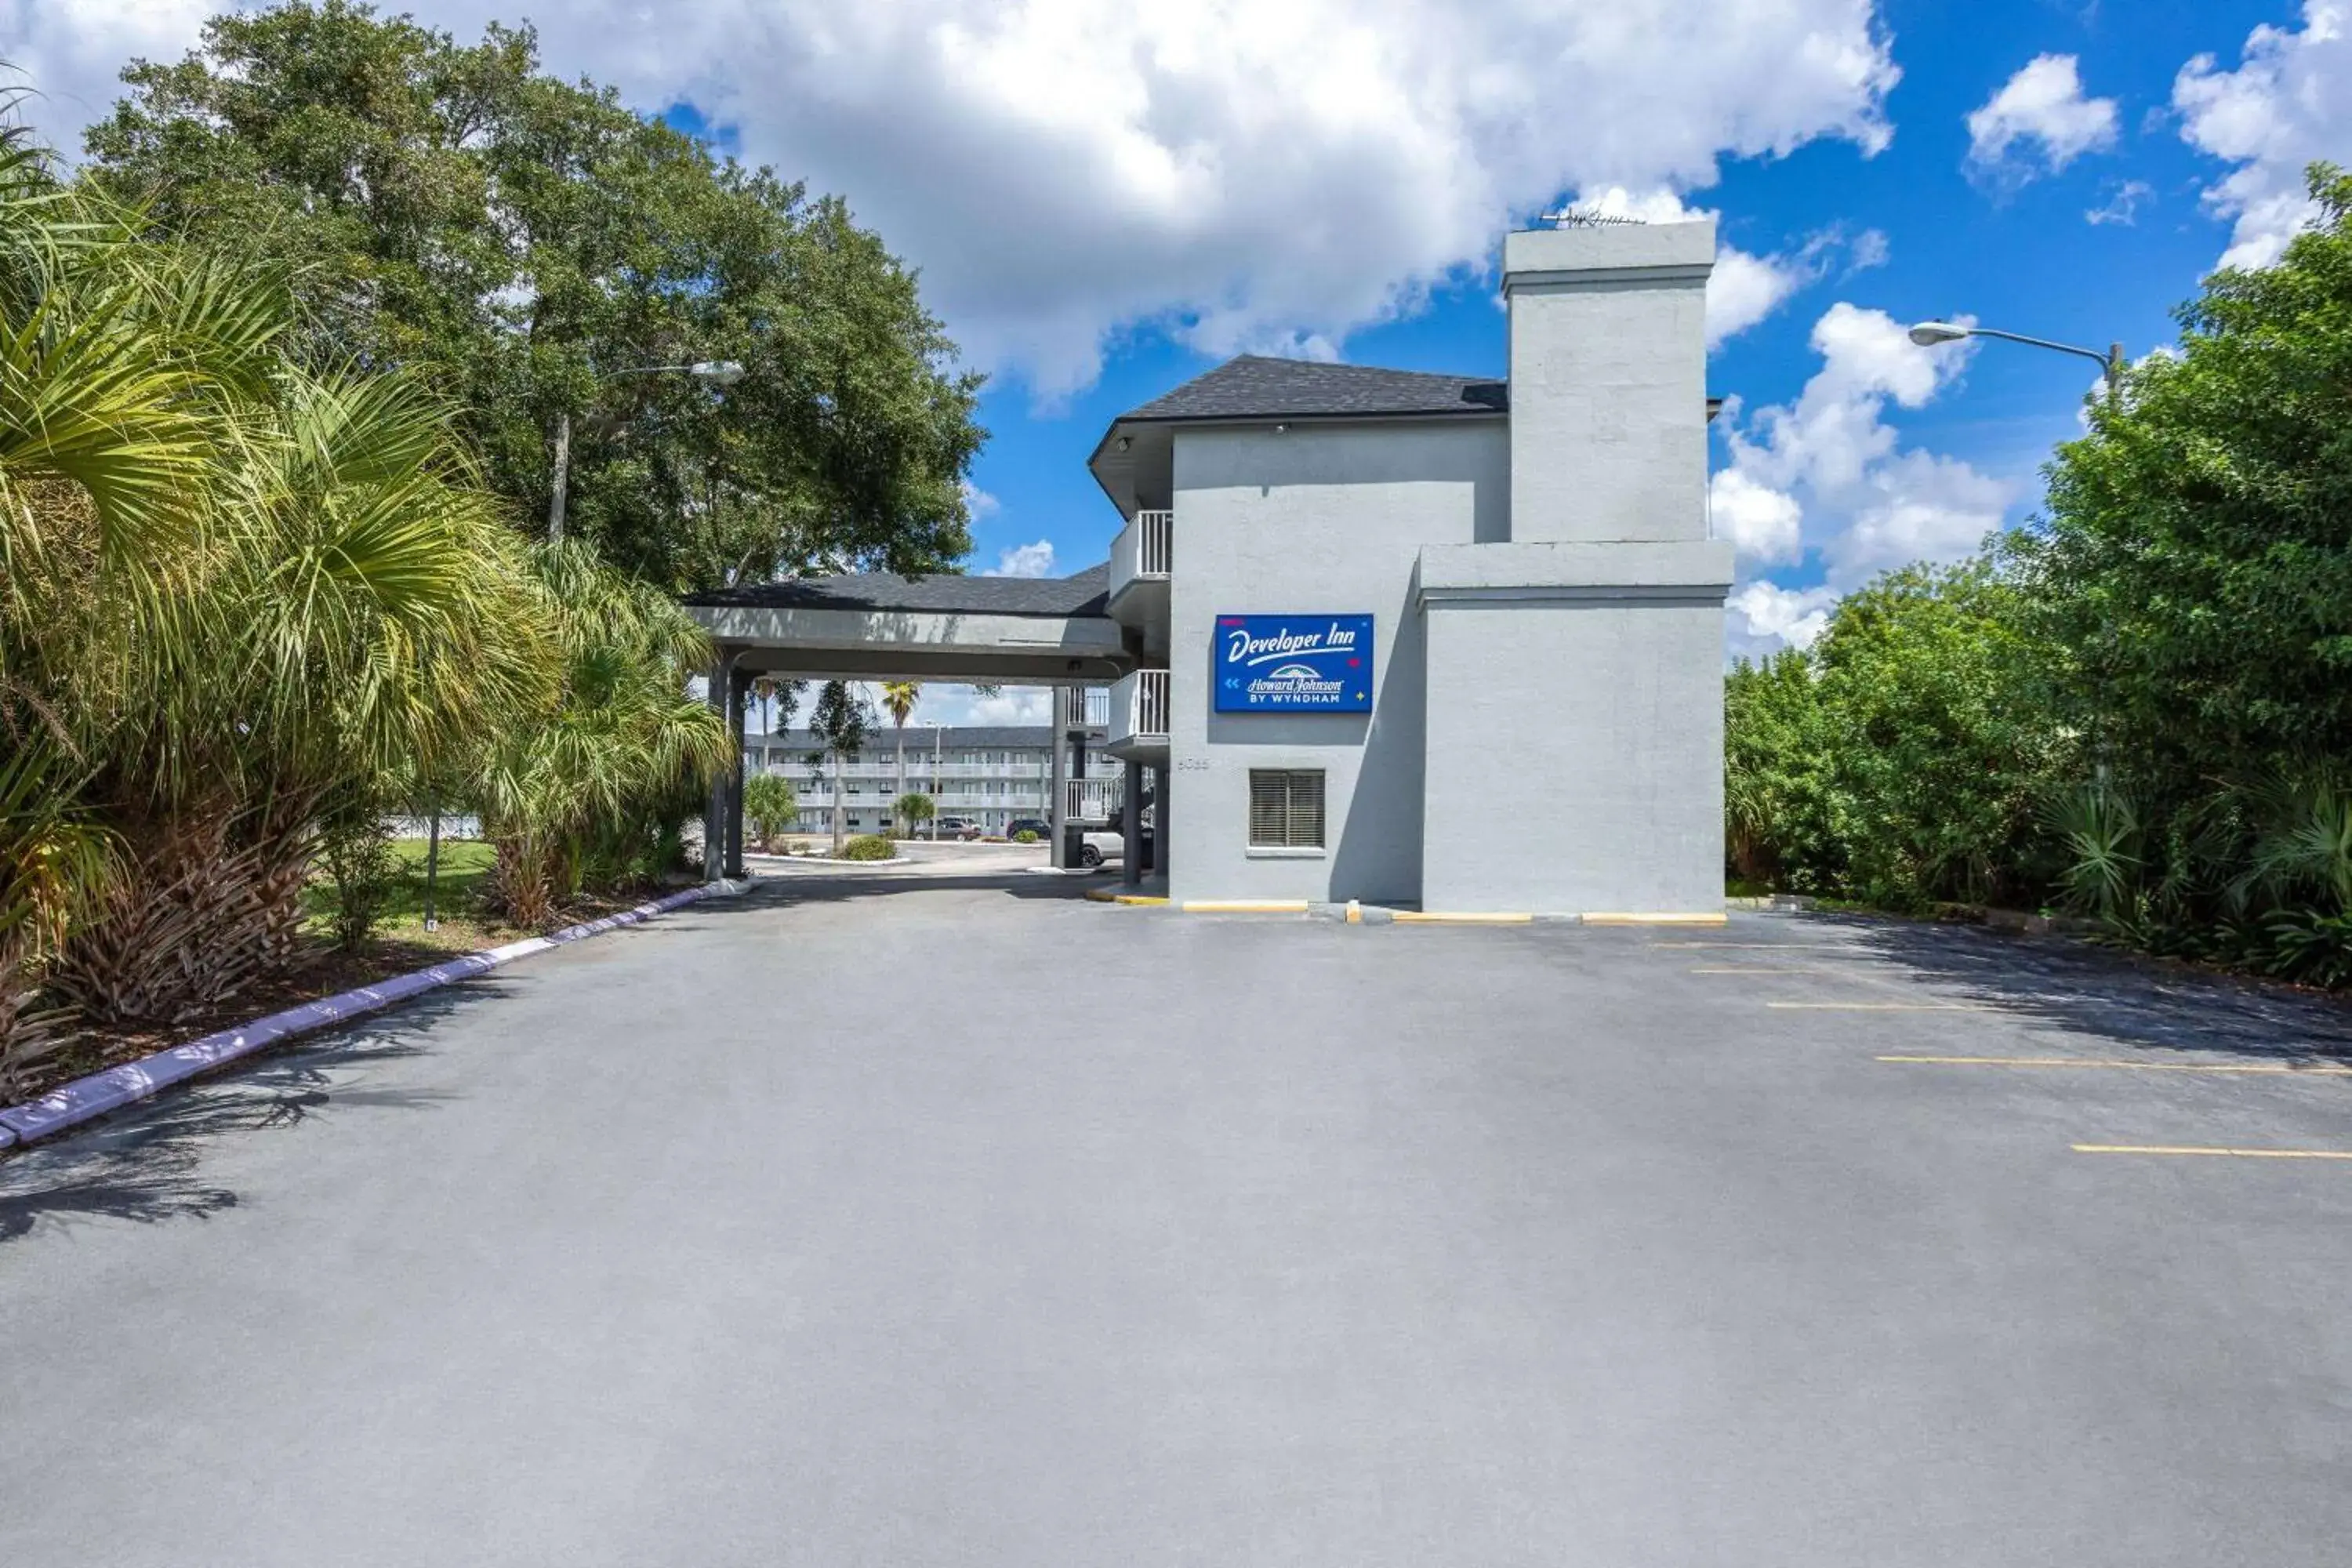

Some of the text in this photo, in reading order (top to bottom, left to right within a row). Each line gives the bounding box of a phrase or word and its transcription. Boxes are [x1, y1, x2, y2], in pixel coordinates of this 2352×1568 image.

[1229, 622, 1356, 662] Developer Inn
[1247, 678, 1341, 693] Howard Johnson
[1250, 694, 1340, 703] BY WYNDHAM
